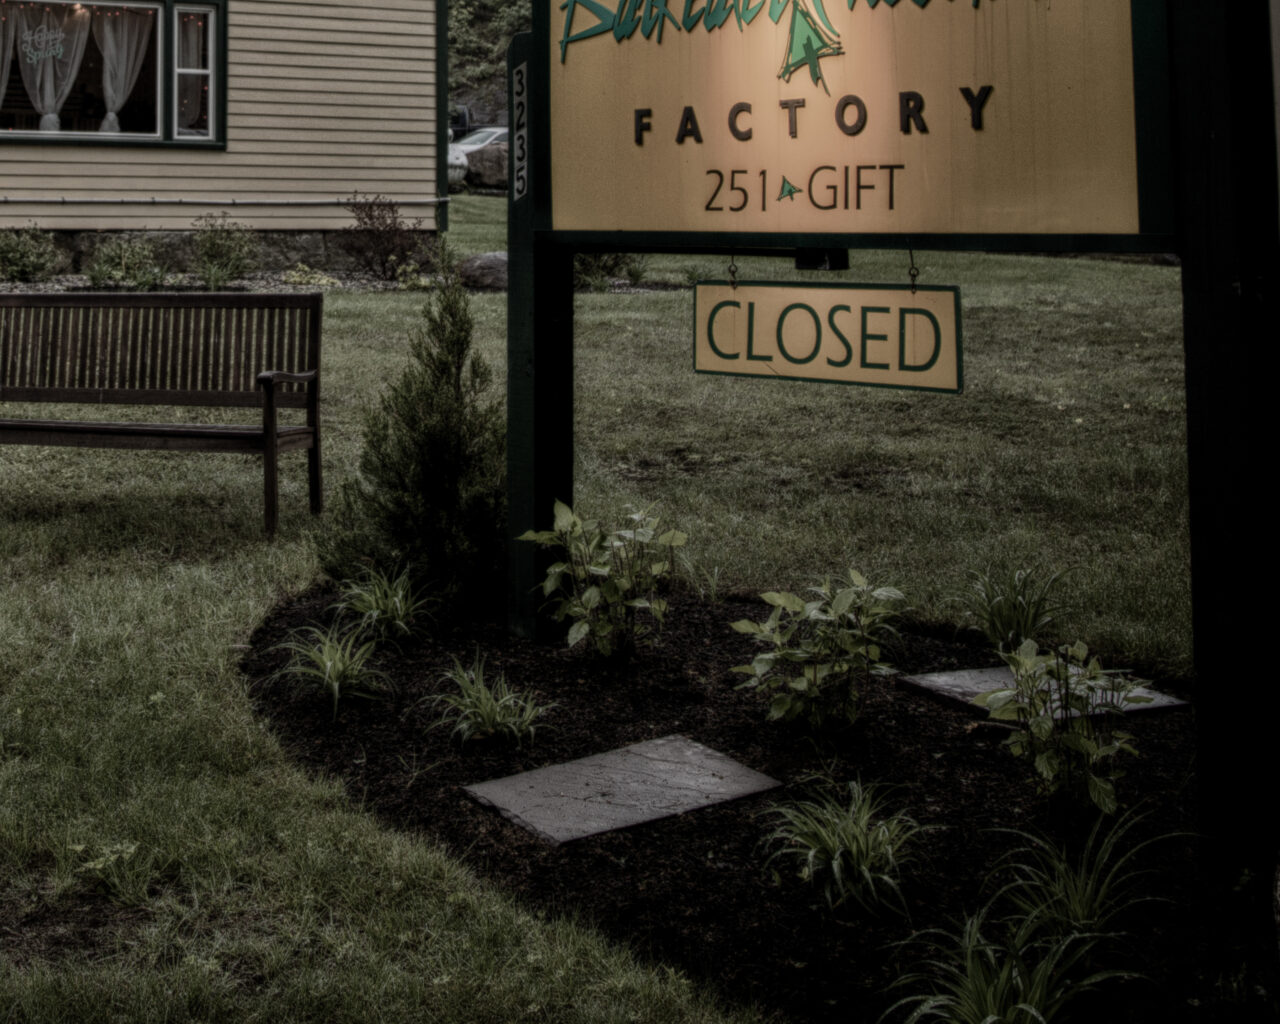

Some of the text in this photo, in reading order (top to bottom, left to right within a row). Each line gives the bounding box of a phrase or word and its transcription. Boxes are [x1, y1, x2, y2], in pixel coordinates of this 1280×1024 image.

[515, 70, 526, 195] 3235
[634, 86, 994, 146] FACTORY
[705, 165, 905, 212] 251 GIFT
[707, 300, 942, 372] CLOSED
